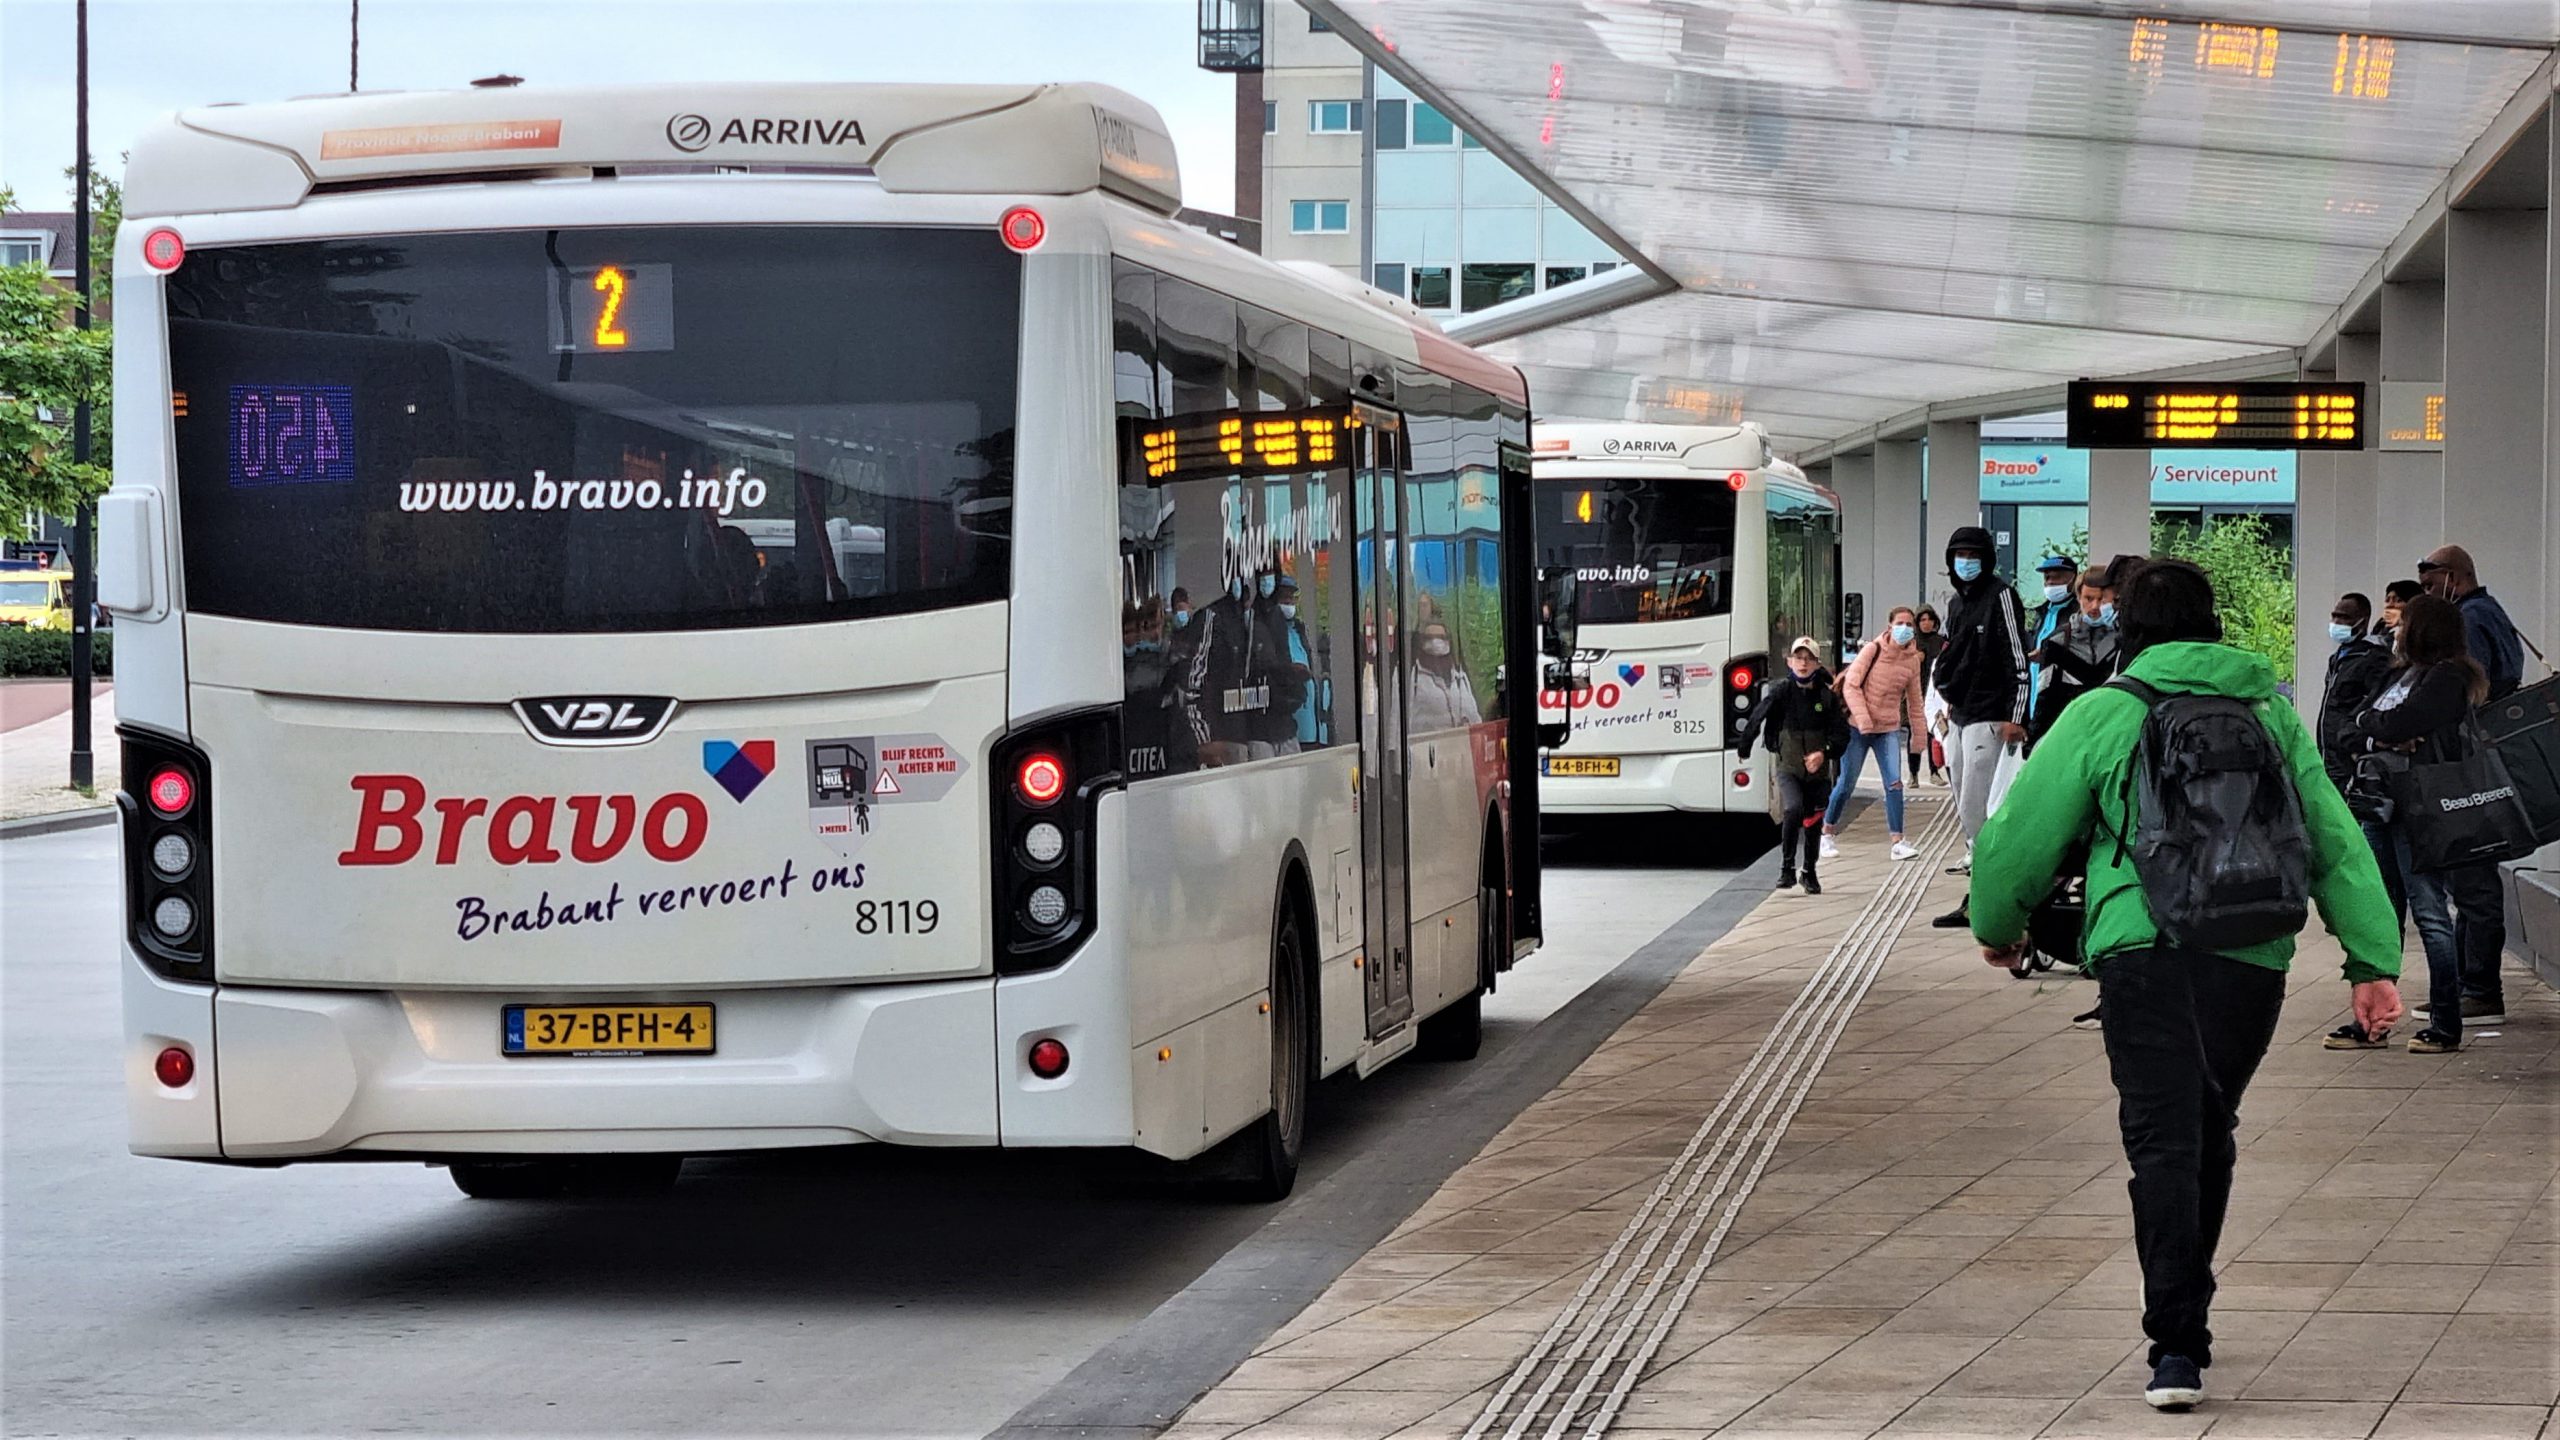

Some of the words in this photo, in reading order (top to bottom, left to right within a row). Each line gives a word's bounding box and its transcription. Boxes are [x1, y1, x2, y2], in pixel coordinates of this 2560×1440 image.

[719, 118, 867, 146] ARRIVA
[594, 266, 626, 346] 2
[1623, 440, 1677, 452] ARRIVA
[1983, 460, 2038, 475] Bravo
[2165, 465, 2278, 486] Servicepunt
[399, 468, 767, 516] www.bravo.info
[1576, 490, 1593, 524] 4
[1997, 534, 2009, 542] 57
[1539, 684, 1620, 709] avo
[540, 702, 649, 731] VDL
[1595, 707, 1652, 728] vervoert
[1657, 709, 1678, 720] ons
[1673, 720, 1705, 734] 8125
[881, 748, 906, 761] BLIJF
[909, 747, 945, 760] RECHTS
[1129, 746, 1166, 774] CITEA
[897, 761, 934, 774] ACHTER
[1552, 761, 1615, 773] 44-BFH-4
[337, 774, 709, 866] Bravo
[825, 825, 847, 833] METER
[456, 881, 625, 941] Brabant
[638, 858, 799, 917] vervoert
[811, 860, 867, 893] ons
[855, 899, 940, 936] 8119
[508, 1033, 523, 1043] NL
[537, 1012, 696, 1044] 37-BFH-4
